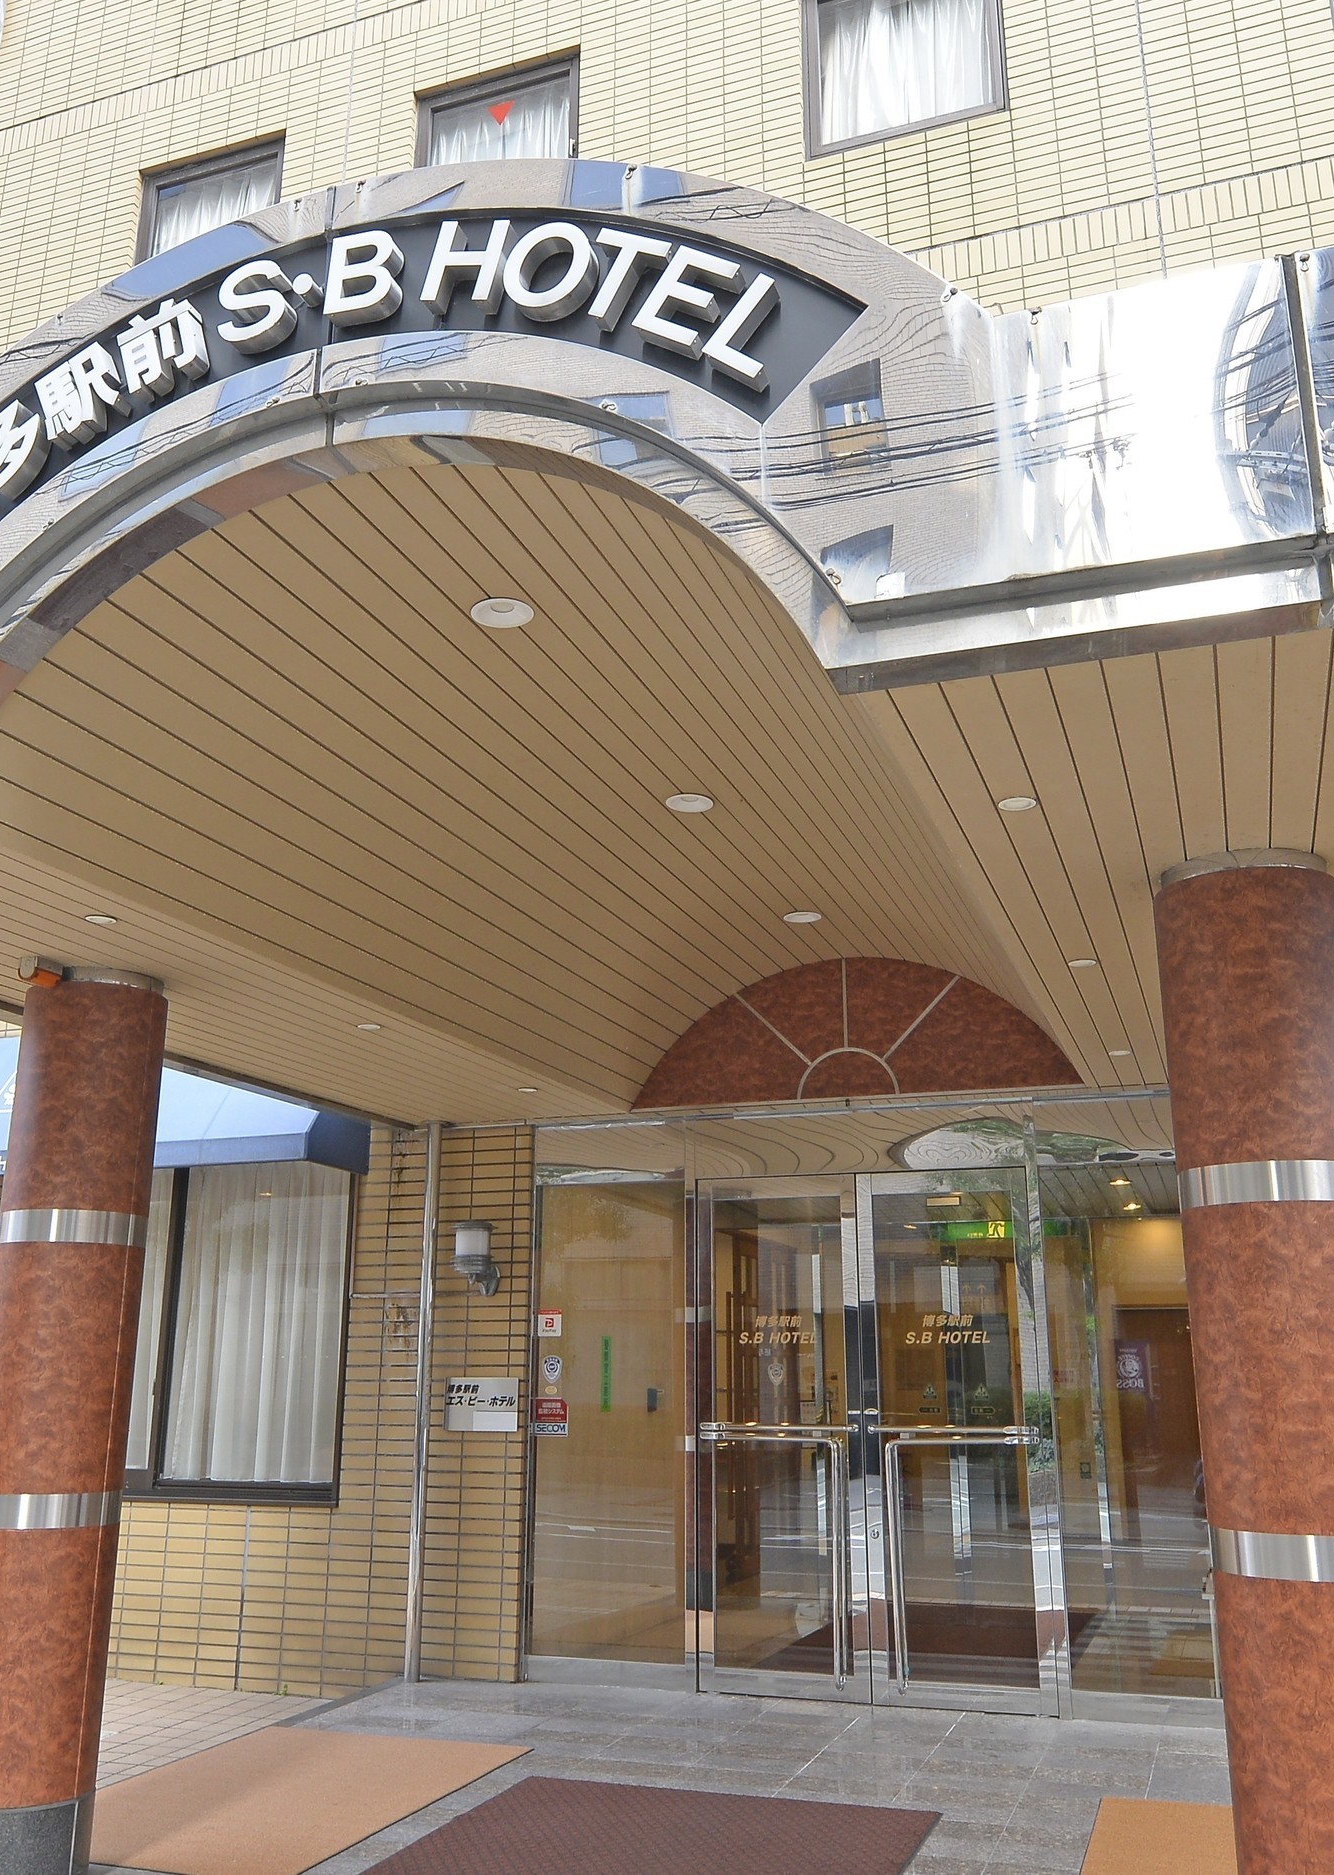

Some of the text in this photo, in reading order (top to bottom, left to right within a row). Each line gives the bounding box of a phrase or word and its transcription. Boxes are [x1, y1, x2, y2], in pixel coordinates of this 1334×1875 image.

[420, 219, 778, 386] HOTEL
[755, 1315, 803, 1327] 博多駅前
[922, 1314, 974, 1327] 博多駅前
[738, 1331, 817, 1345] S.B HOTEL
[905, 1331, 991, 1345] S.B HOTEL
[447, 1384, 479, 1394] 博多駅前
[536, 1424, 566, 1433] SECOM
